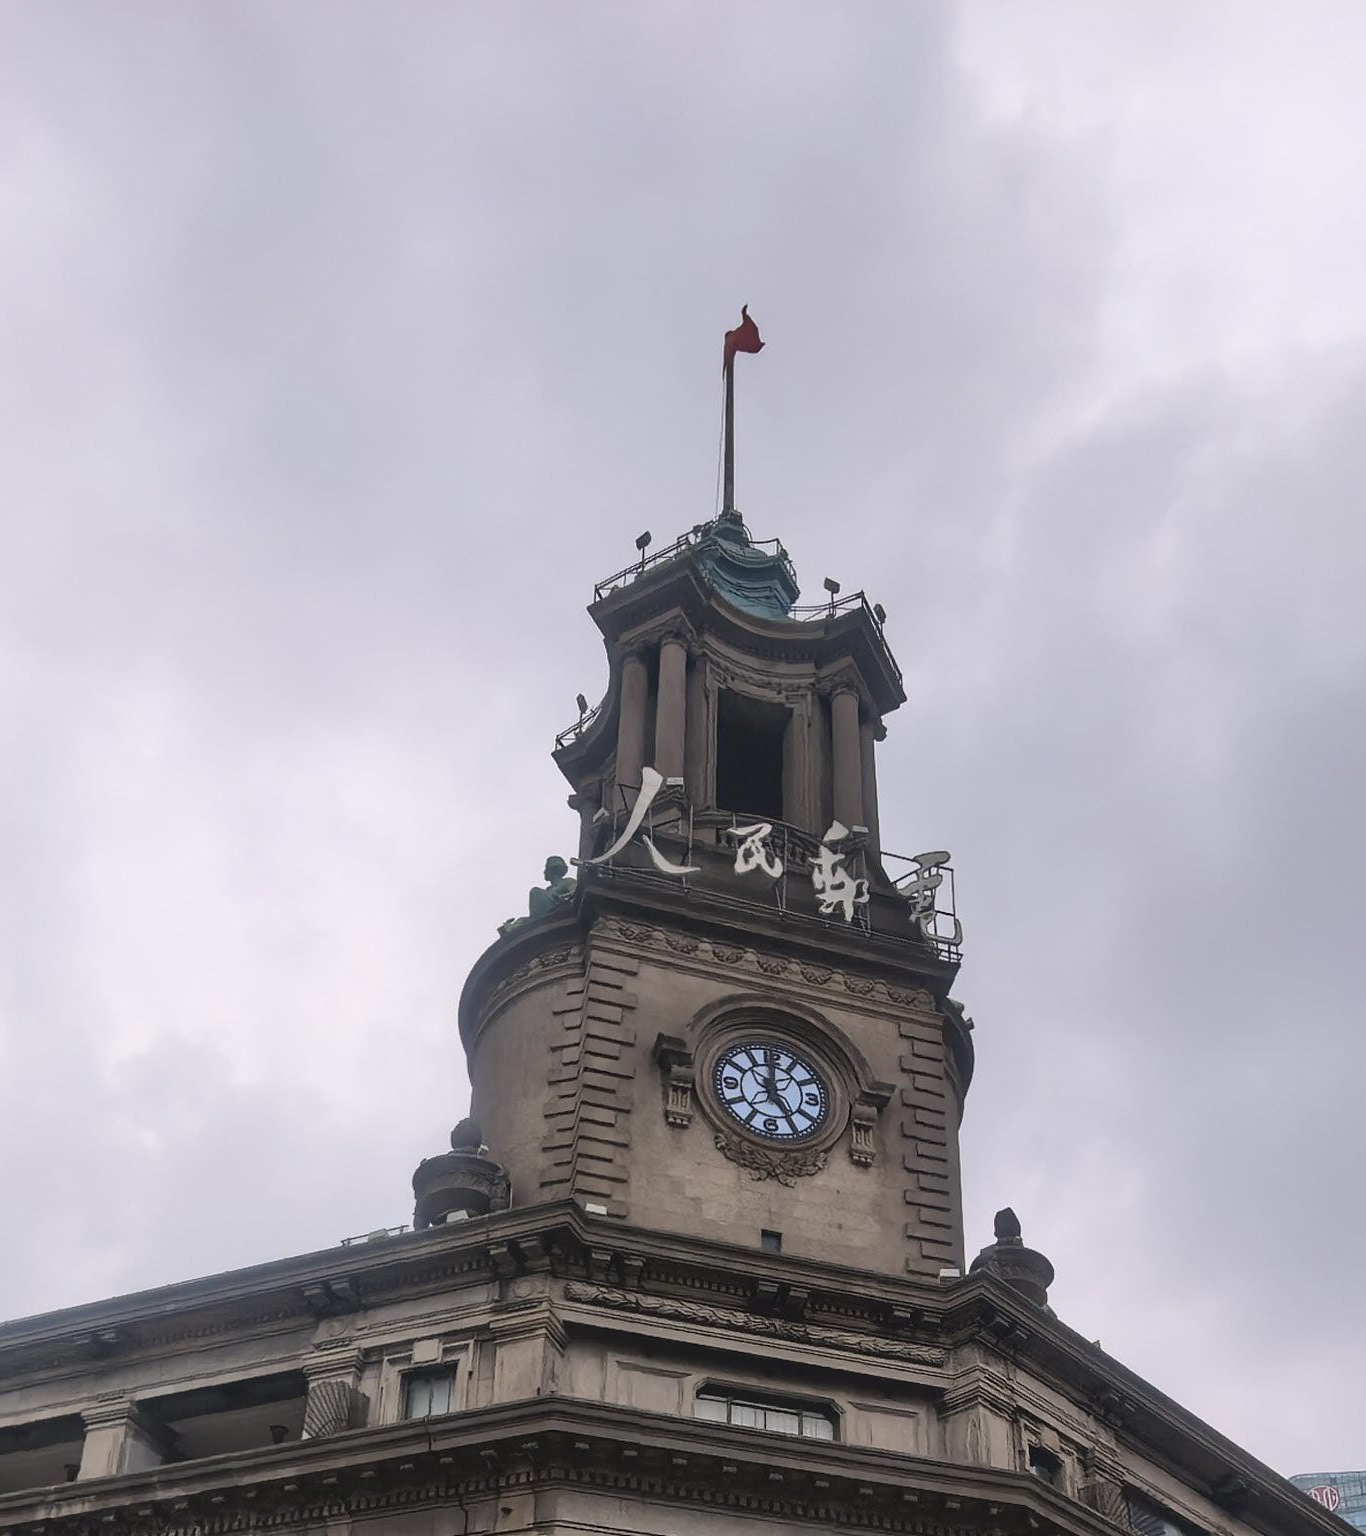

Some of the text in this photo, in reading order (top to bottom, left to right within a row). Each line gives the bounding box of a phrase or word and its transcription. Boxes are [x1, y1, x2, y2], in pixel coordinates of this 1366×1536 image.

[723, 1076, 739, 1090] 9
[804, 1092, 819, 1107] 3
[763, 1118, 779, 1132] 6
